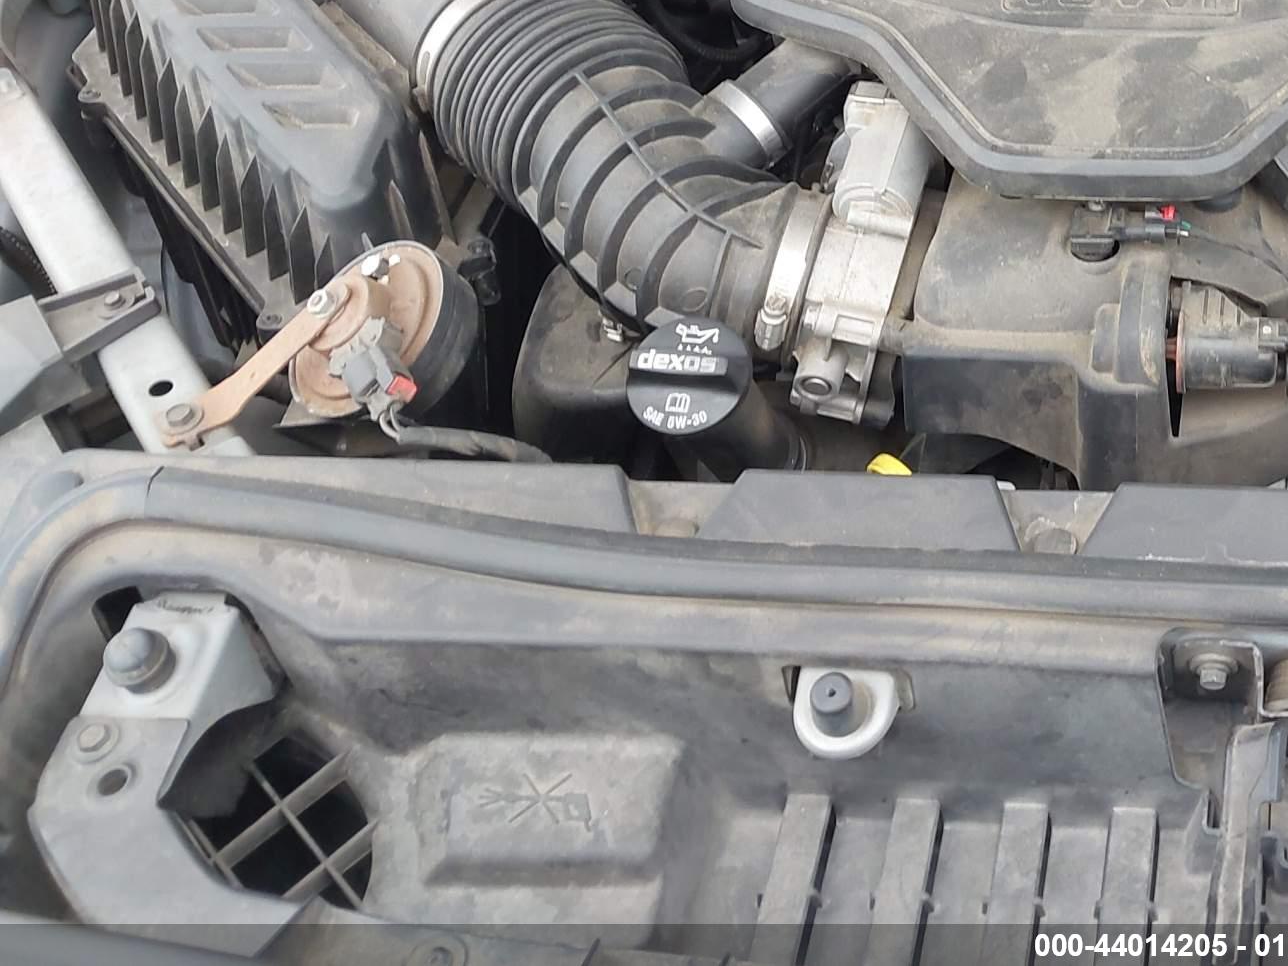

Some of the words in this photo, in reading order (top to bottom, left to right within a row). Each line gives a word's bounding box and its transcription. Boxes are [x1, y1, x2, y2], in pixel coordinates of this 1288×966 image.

[637, 348, 717, 373] dexos
[642, 405, 665, 427] SAE
[667, 410, 708, 430] 0W-30
